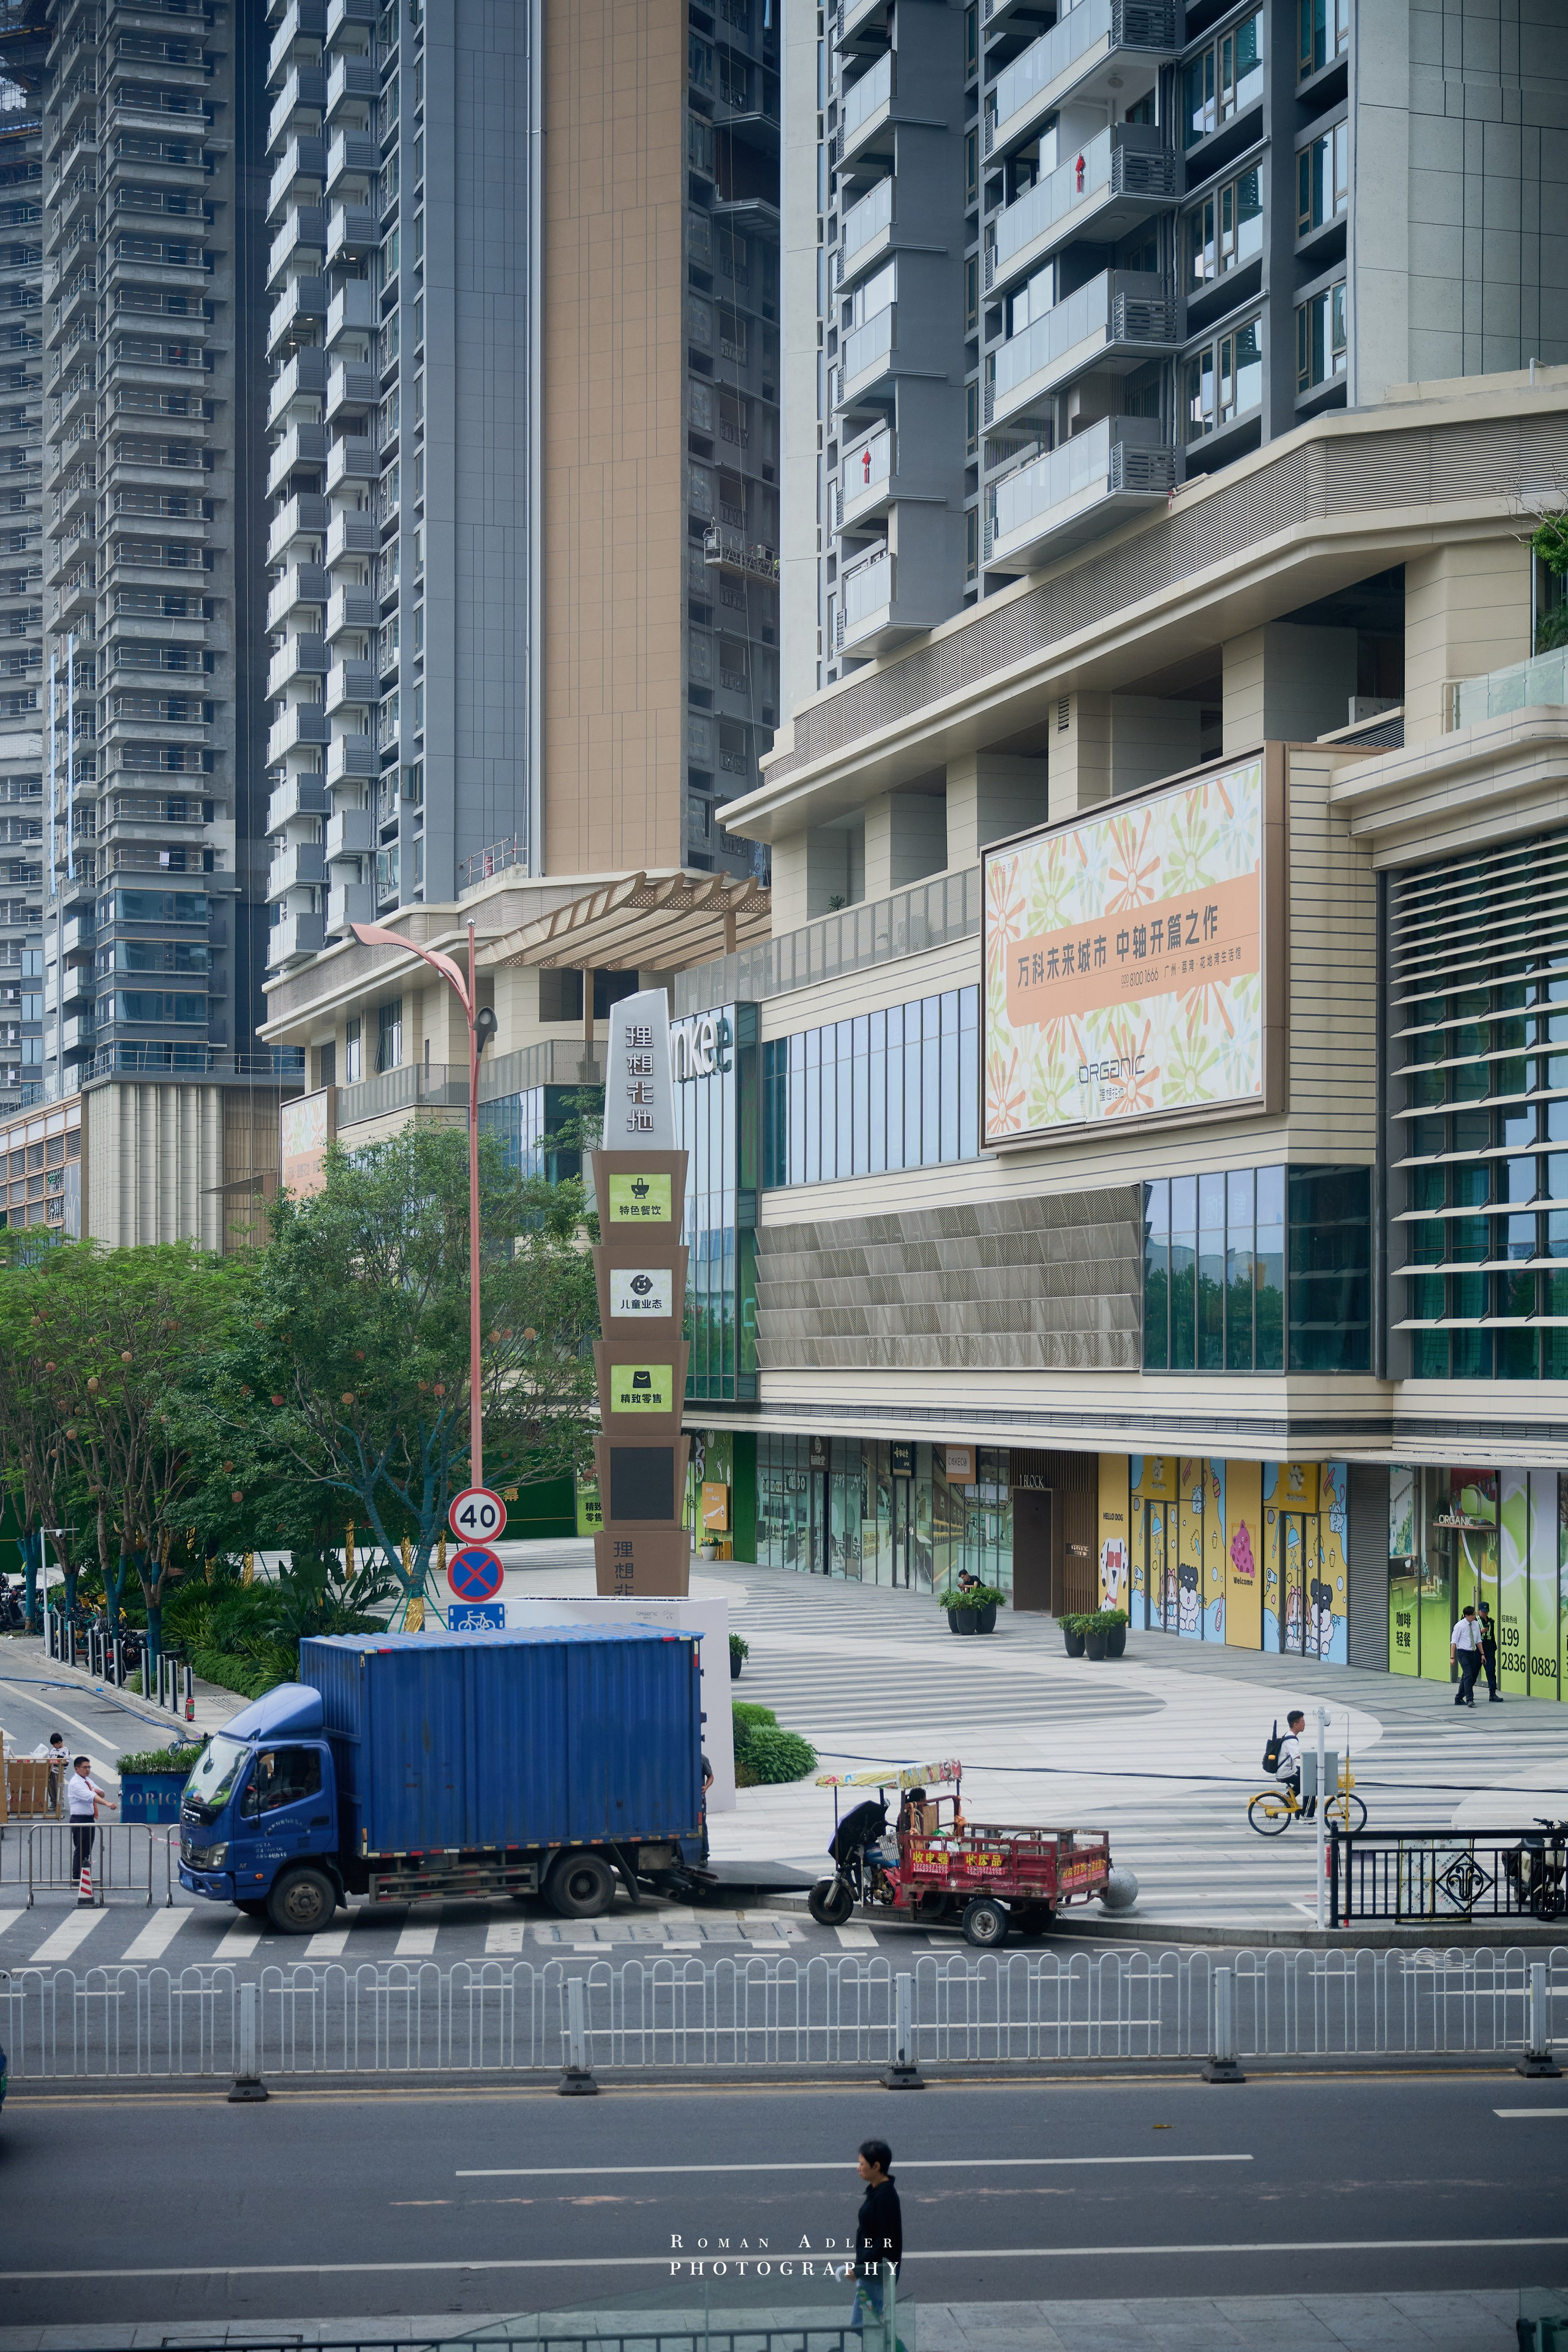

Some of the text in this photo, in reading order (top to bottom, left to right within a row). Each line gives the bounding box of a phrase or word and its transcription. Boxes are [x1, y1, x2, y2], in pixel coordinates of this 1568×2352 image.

[1017, 905, 1218, 989] 万科未来城市 中轴开篇之作
[1130, 971, 1144, 987] 8100
[1145, 967, 1158, 984] 1666
[671, 1017, 718, 1081] nke
[626, 1025, 654, 1132] 理想花地
[619, 1205, 662, 1216] 特色餐饮
[620, 1299, 662, 1310] 儿童业态
[620, 1393, 662, 1404] 精致零售
[1023, 1475, 1044, 1489] BLOCK
[460, 1504, 496, 1528] 40
[586, 1513, 602, 1522] 零售
[1439, 1514, 1474, 1526] ORGANIC
[1233, 1576, 1253, 1586] Welcome
[1396, 1611, 1411, 1628] 咖啡
[1501, 1614, 1518, 1624] 招商热线
[1396, 1630, 1411, 1648] 轻餐
[1501, 1627, 1519, 1647] 199
[1501, 1651, 1526, 1673] 2836
[1531, 1656, 1557, 1678] 0882
[130, 1792, 176, 1806] ORIG
[913, 1850, 949, 1865] 收电器
